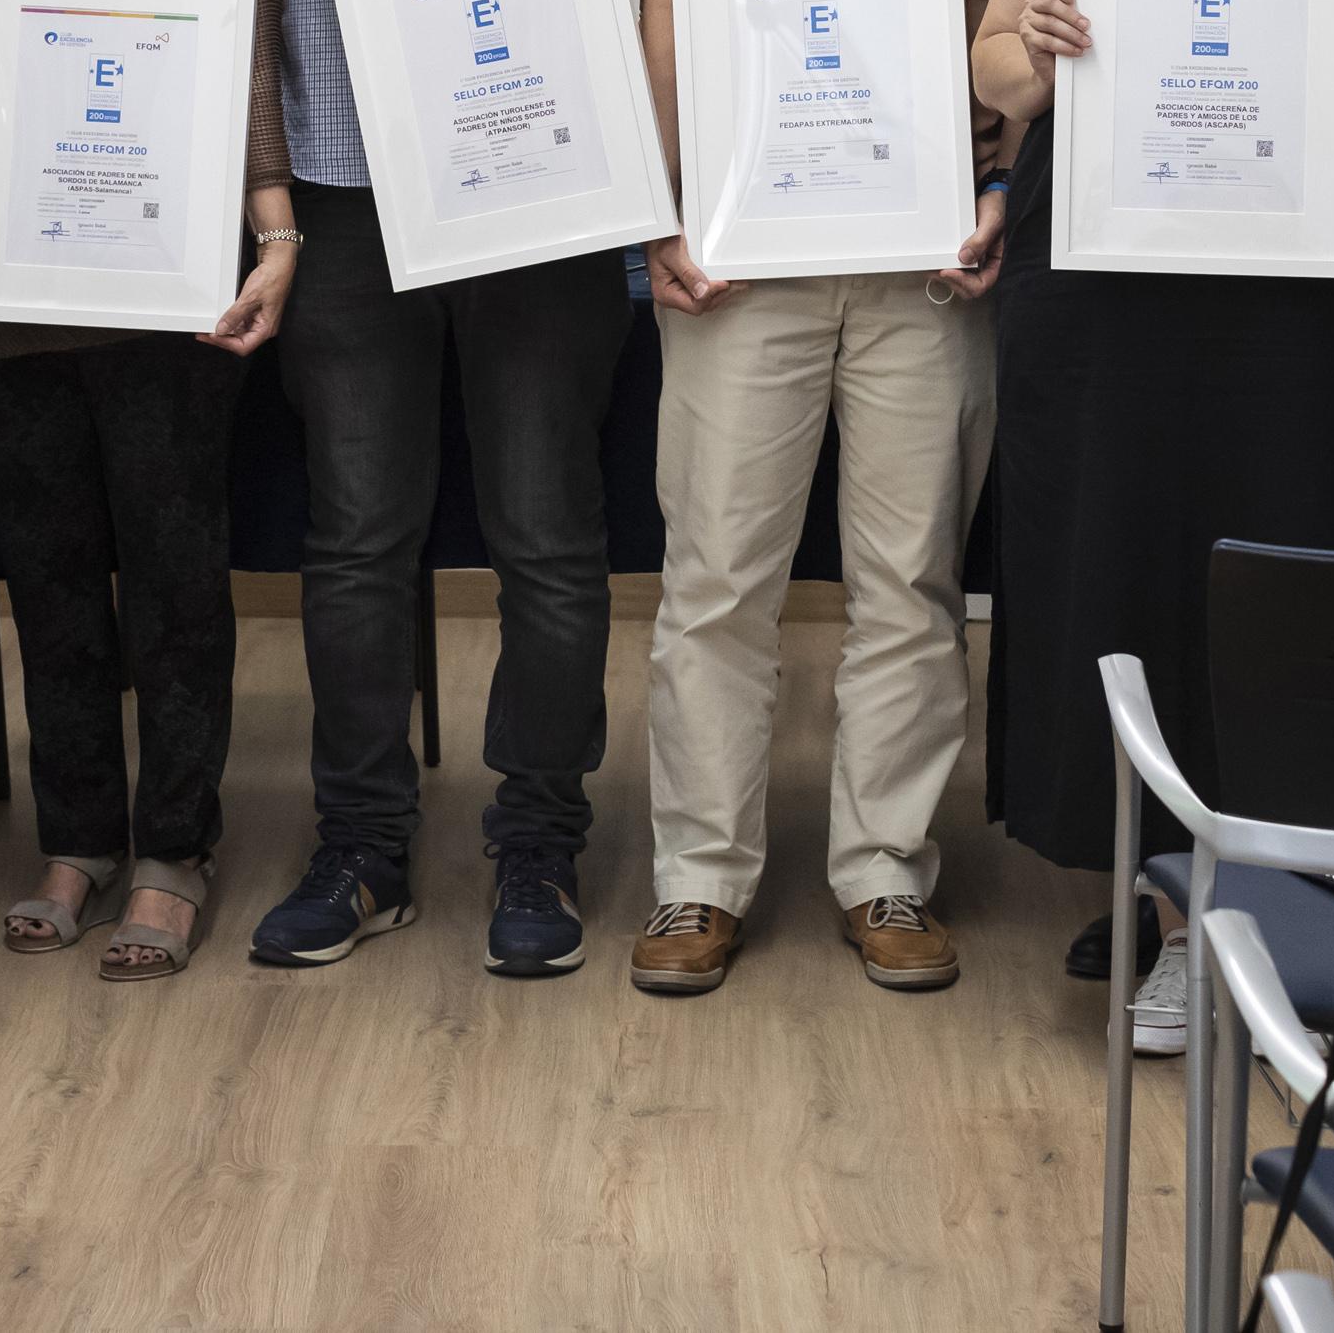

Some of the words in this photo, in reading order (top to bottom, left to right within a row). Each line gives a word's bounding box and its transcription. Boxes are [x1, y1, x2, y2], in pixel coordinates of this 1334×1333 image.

[1195, 45, 1211, 53] 200
[478, 53, 493, 62] 200
[453, 87, 486, 101] SELLO
[490, 80, 522, 94] EFQM
[525, 76, 543, 87] 200
[1161, 78, 1196, 88] SELLO
[1200, 79, 1234, 89] EFQM
[1238, 81, 1259, 90] 200
[779, 92, 812, 103] SELLO
[816, 90, 848, 100] EFQM
[852, 89, 871, 99] 200
[453, 111, 499, 126] ASOCIACIÓN
[500, 102, 544, 116] TUROLENSE
[546, 99, 556, 107] DE
[1156, 103, 1203, 111] ASOCIACIÓN
[1205, 104, 1247, 113] CACEREÑA
[457, 122, 490, 134] PADRES
[500, 115, 523, 126] NIÑOS
[525, 109, 556, 120] SORDOS
[779, 120, 814, 129] FEDAPAS
[816, 118, 873, 127] EXTREMADURA
[1204, 121, 1246, 130] (ASCAPAS)
[485, 123, 530, 138] (ATPANSOR)
[56, 143, 89, 152] SELLO
[93, 145, 125, 154] EFQM
[128, 147, 147, 156] 200
[43, 168, 85, 176] ASOCIACIÓN
[138, 172, 159, 180] NIÑOS
[100, 179, 142, 187] SALAMANCA
[68, 186, 132, 194] (ASPAS-Salamanca)
